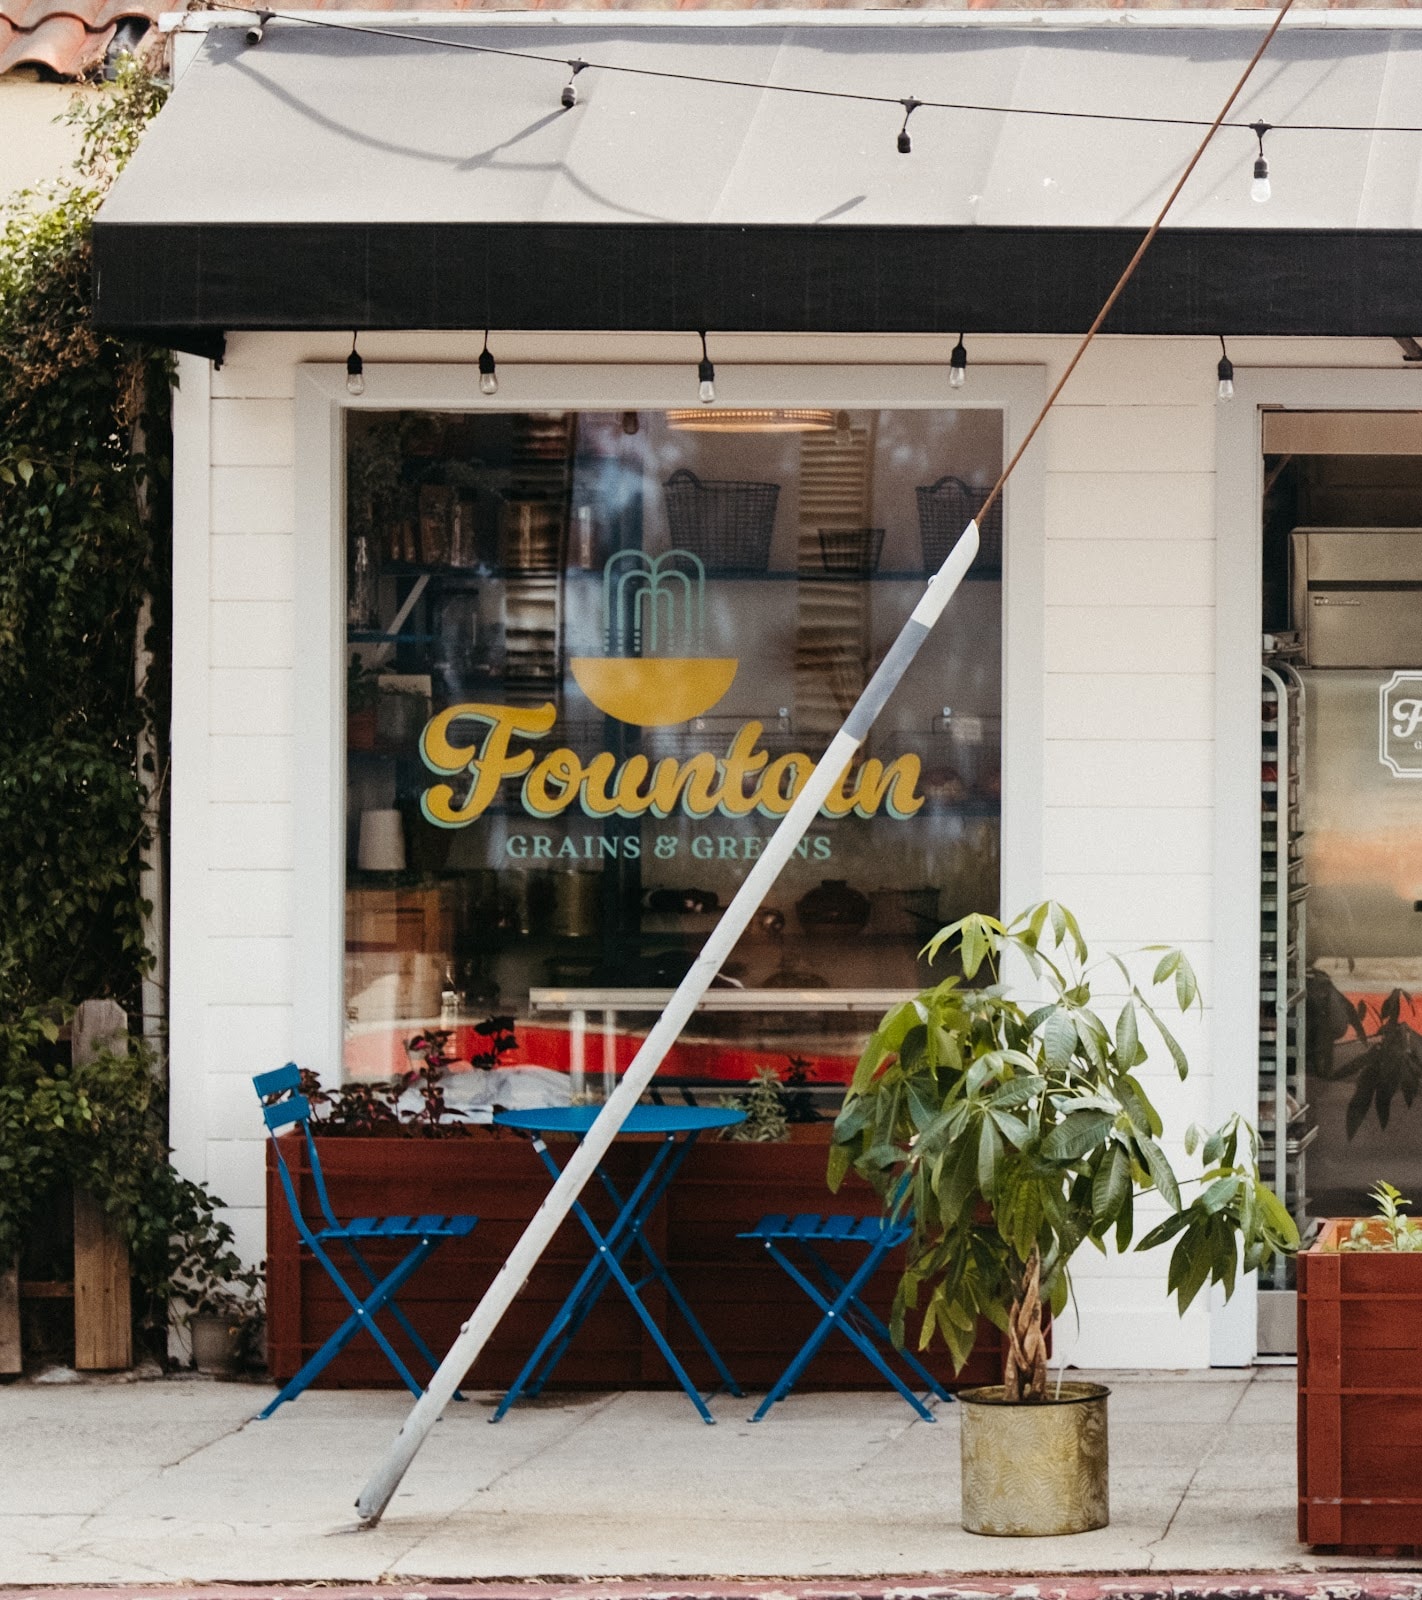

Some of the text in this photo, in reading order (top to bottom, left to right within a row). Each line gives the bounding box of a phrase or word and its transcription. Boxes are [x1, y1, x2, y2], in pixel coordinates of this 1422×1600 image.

[506, 835, 832, 859] GRAINS & GRENS
